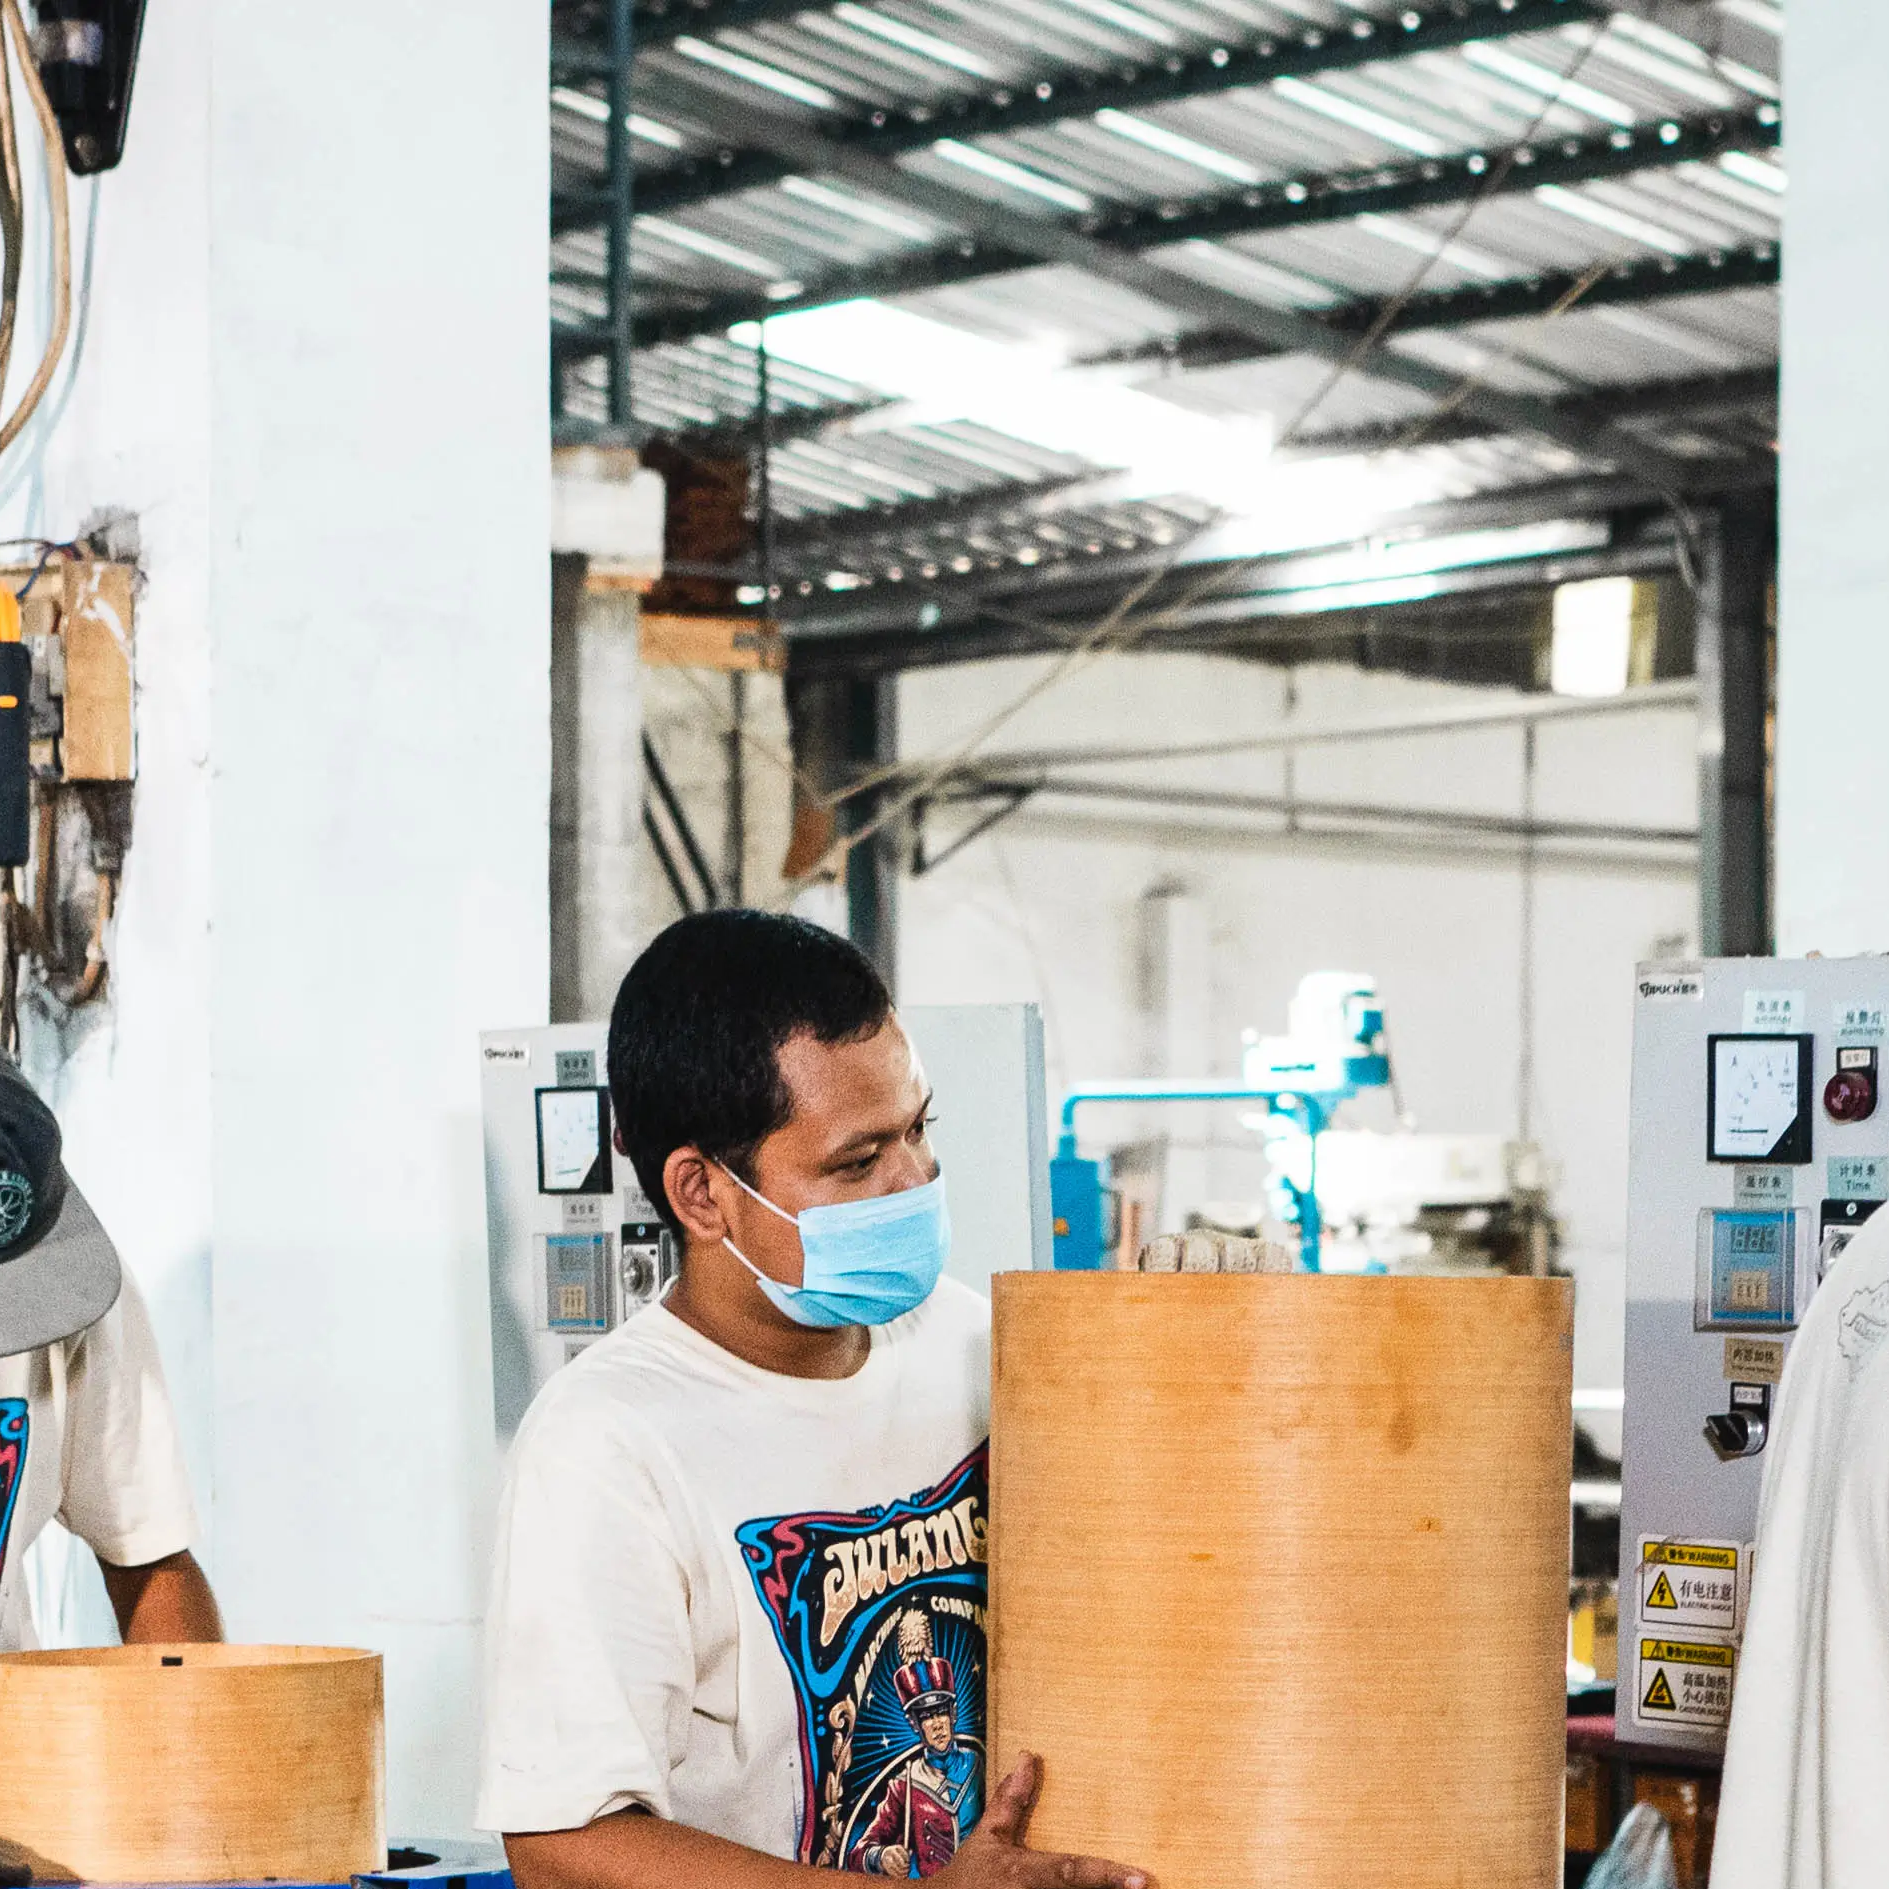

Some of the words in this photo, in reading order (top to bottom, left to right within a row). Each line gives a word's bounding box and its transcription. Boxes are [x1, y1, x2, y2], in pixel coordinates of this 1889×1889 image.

[1845, 1179, 1872, 1192] Time
[1679, 1579, 1733, 1601] 有电注意
